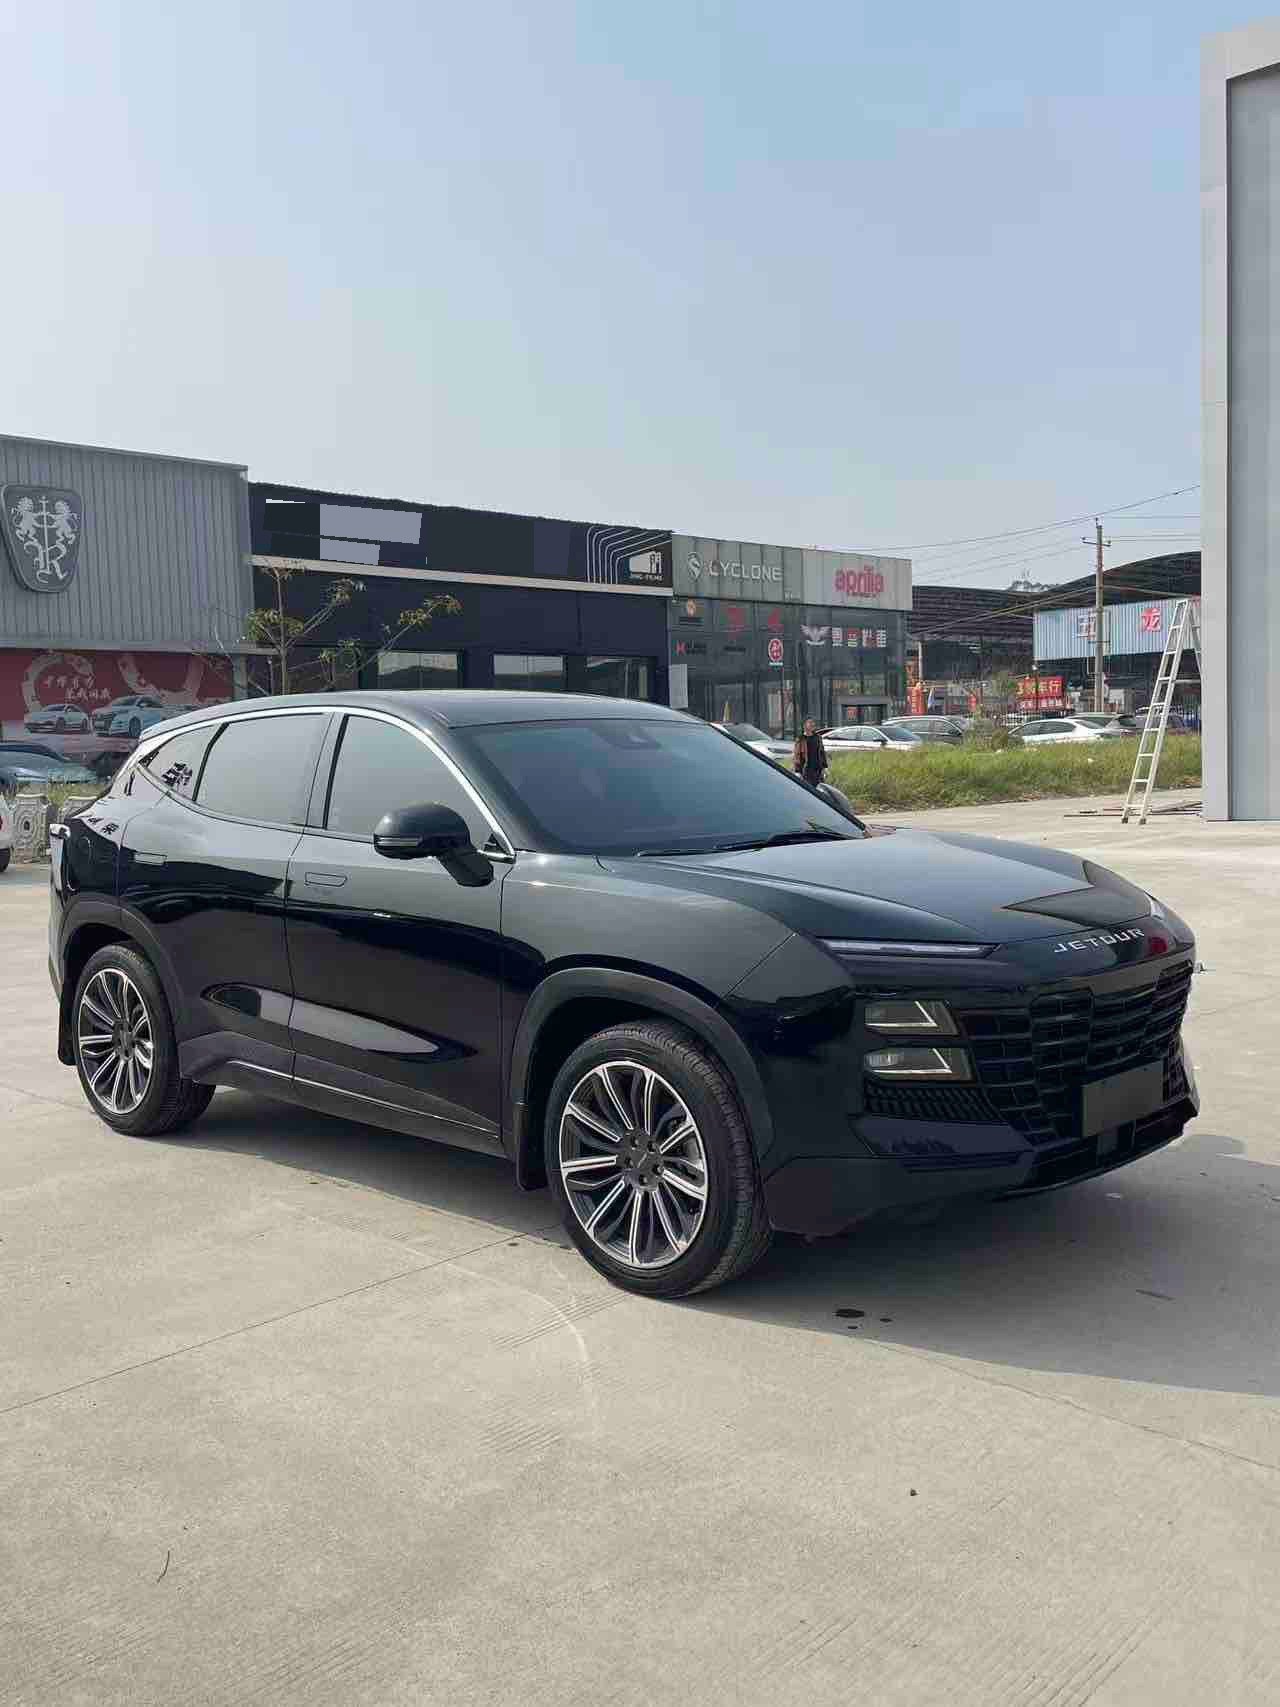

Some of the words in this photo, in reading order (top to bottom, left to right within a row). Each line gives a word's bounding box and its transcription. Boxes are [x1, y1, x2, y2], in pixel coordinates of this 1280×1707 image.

[709, 558, 783, 584] CYCLONE
[835, 565, 885, 595] aprilia
[1054, 926, 1146, 954] JETOUR
